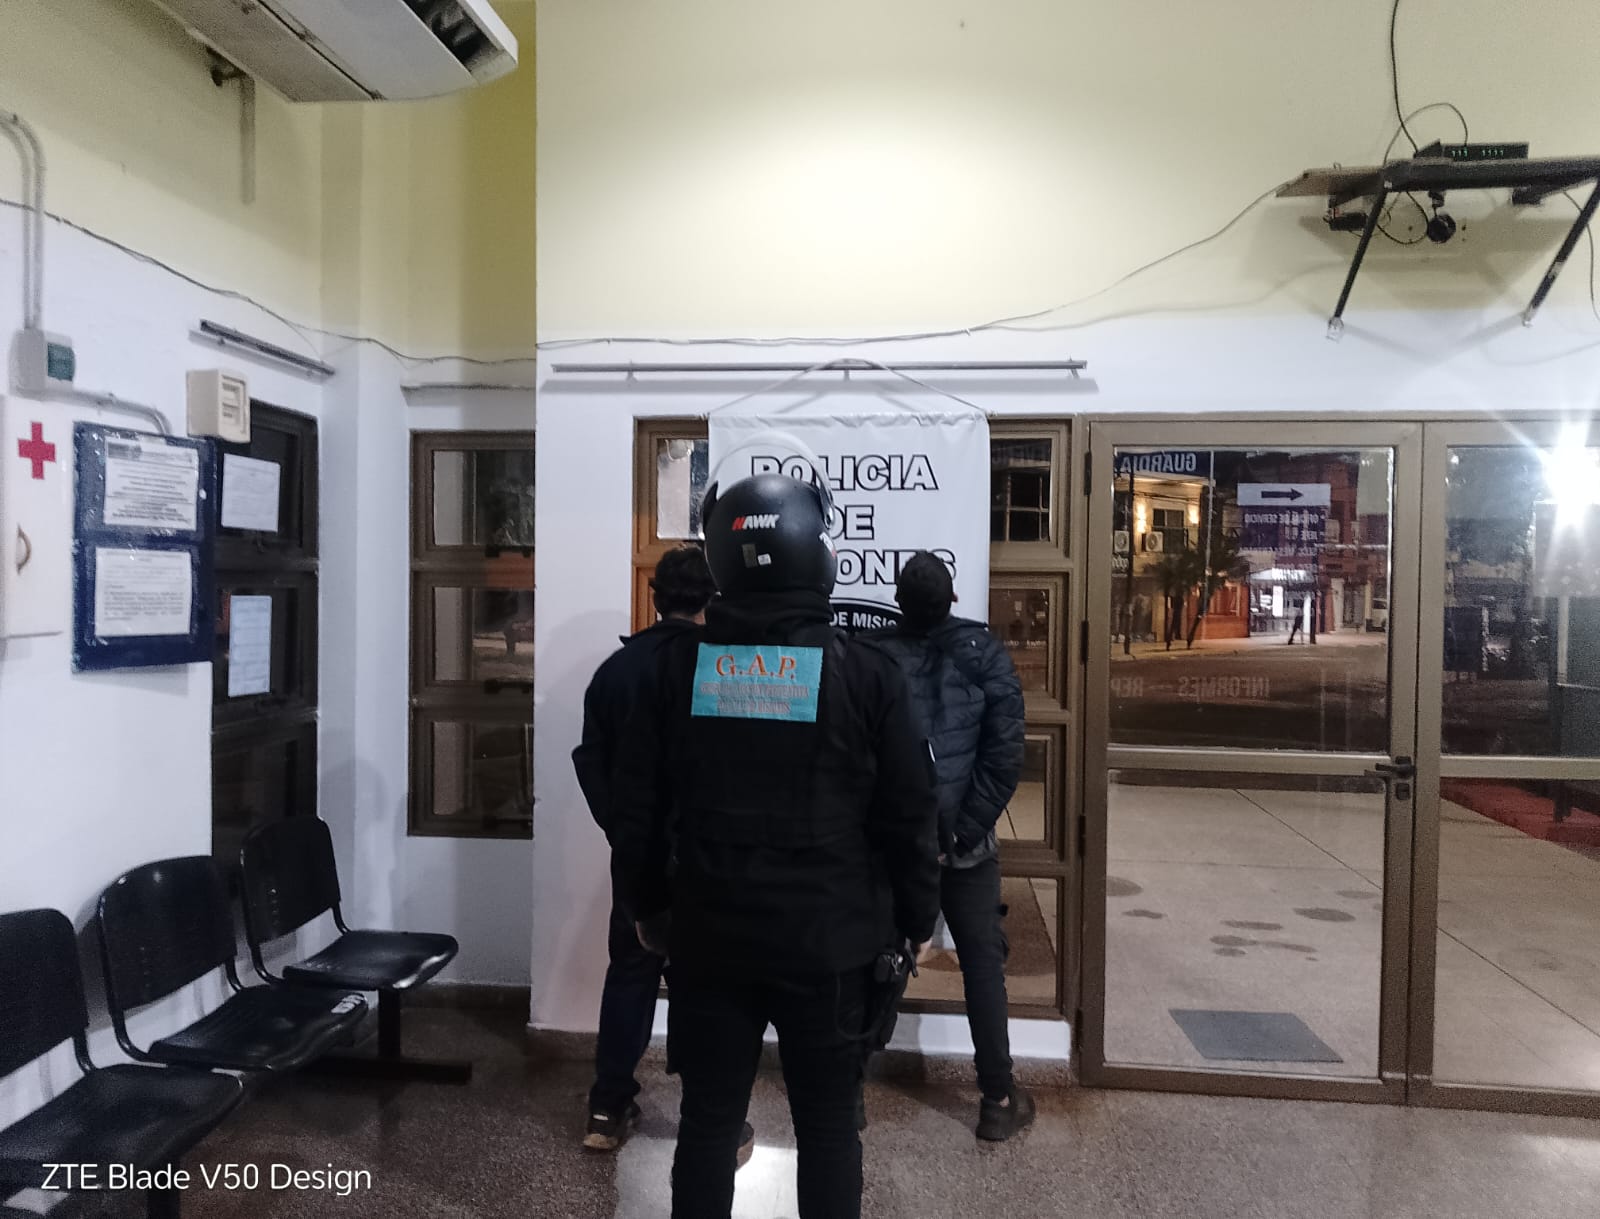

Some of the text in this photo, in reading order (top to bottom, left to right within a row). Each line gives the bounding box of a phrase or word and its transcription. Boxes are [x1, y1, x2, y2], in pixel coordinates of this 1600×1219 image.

[751, 455, 939, 491] POLICIA
[732, 514, 780, 531] HAWK
[716, 654, 796, 680] G.A.P.
